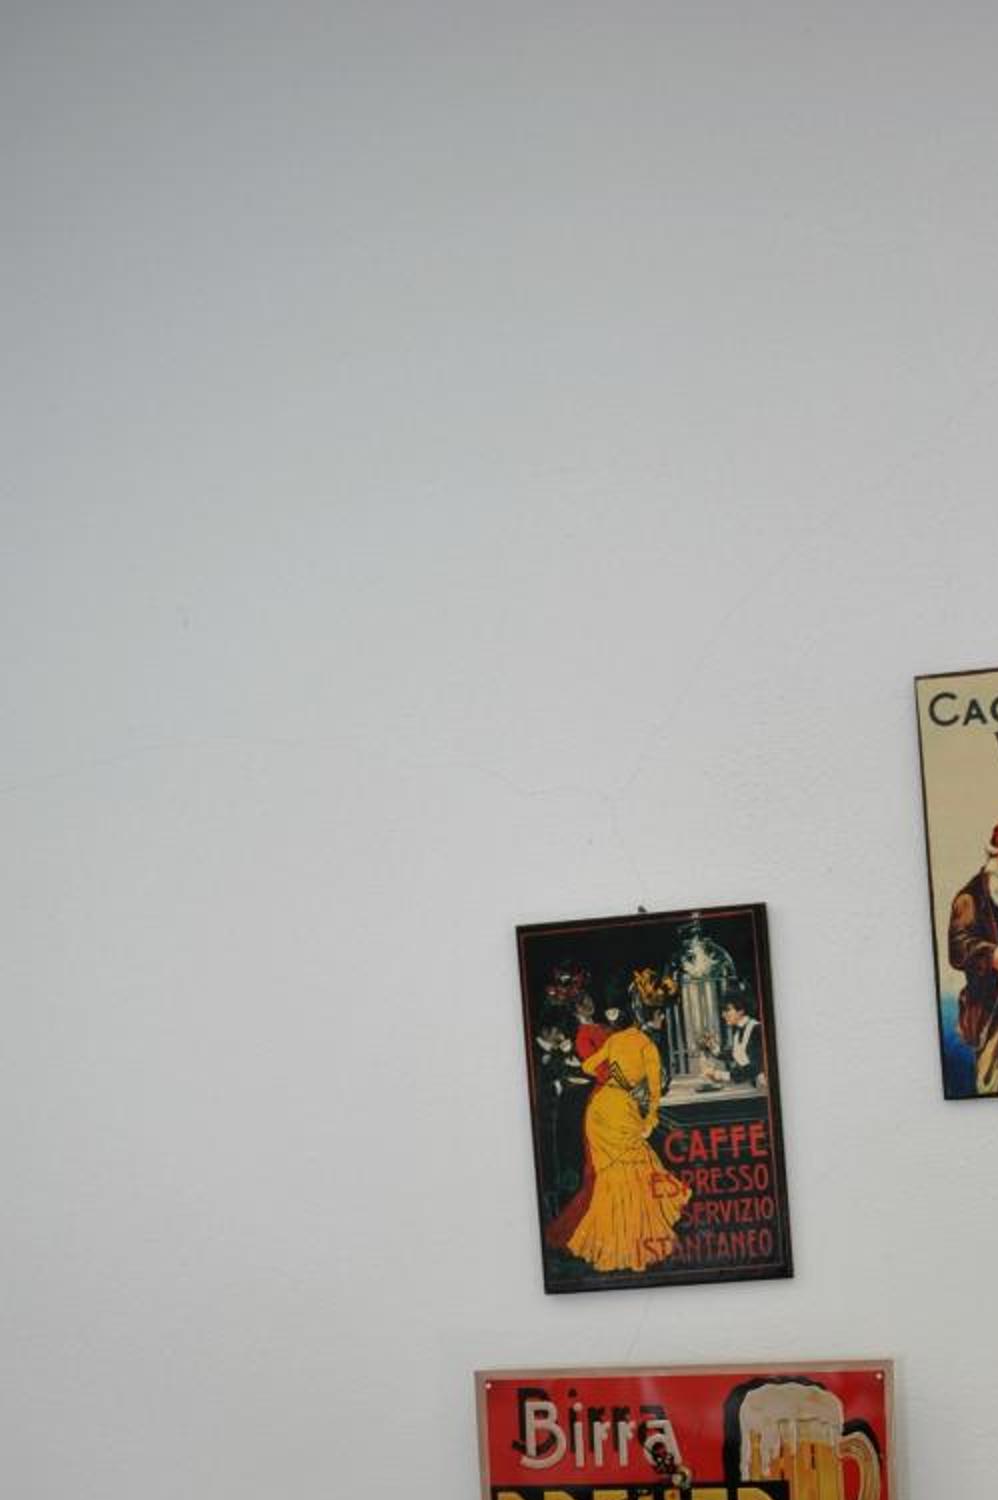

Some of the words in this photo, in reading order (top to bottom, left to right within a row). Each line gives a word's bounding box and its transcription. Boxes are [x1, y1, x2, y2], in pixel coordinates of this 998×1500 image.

[650, 1162, 769, 1200] ESPRESSO
[680, 1196, 775, 1227] SERVIZIO
[513, 1388, 686, 1471] Birra
